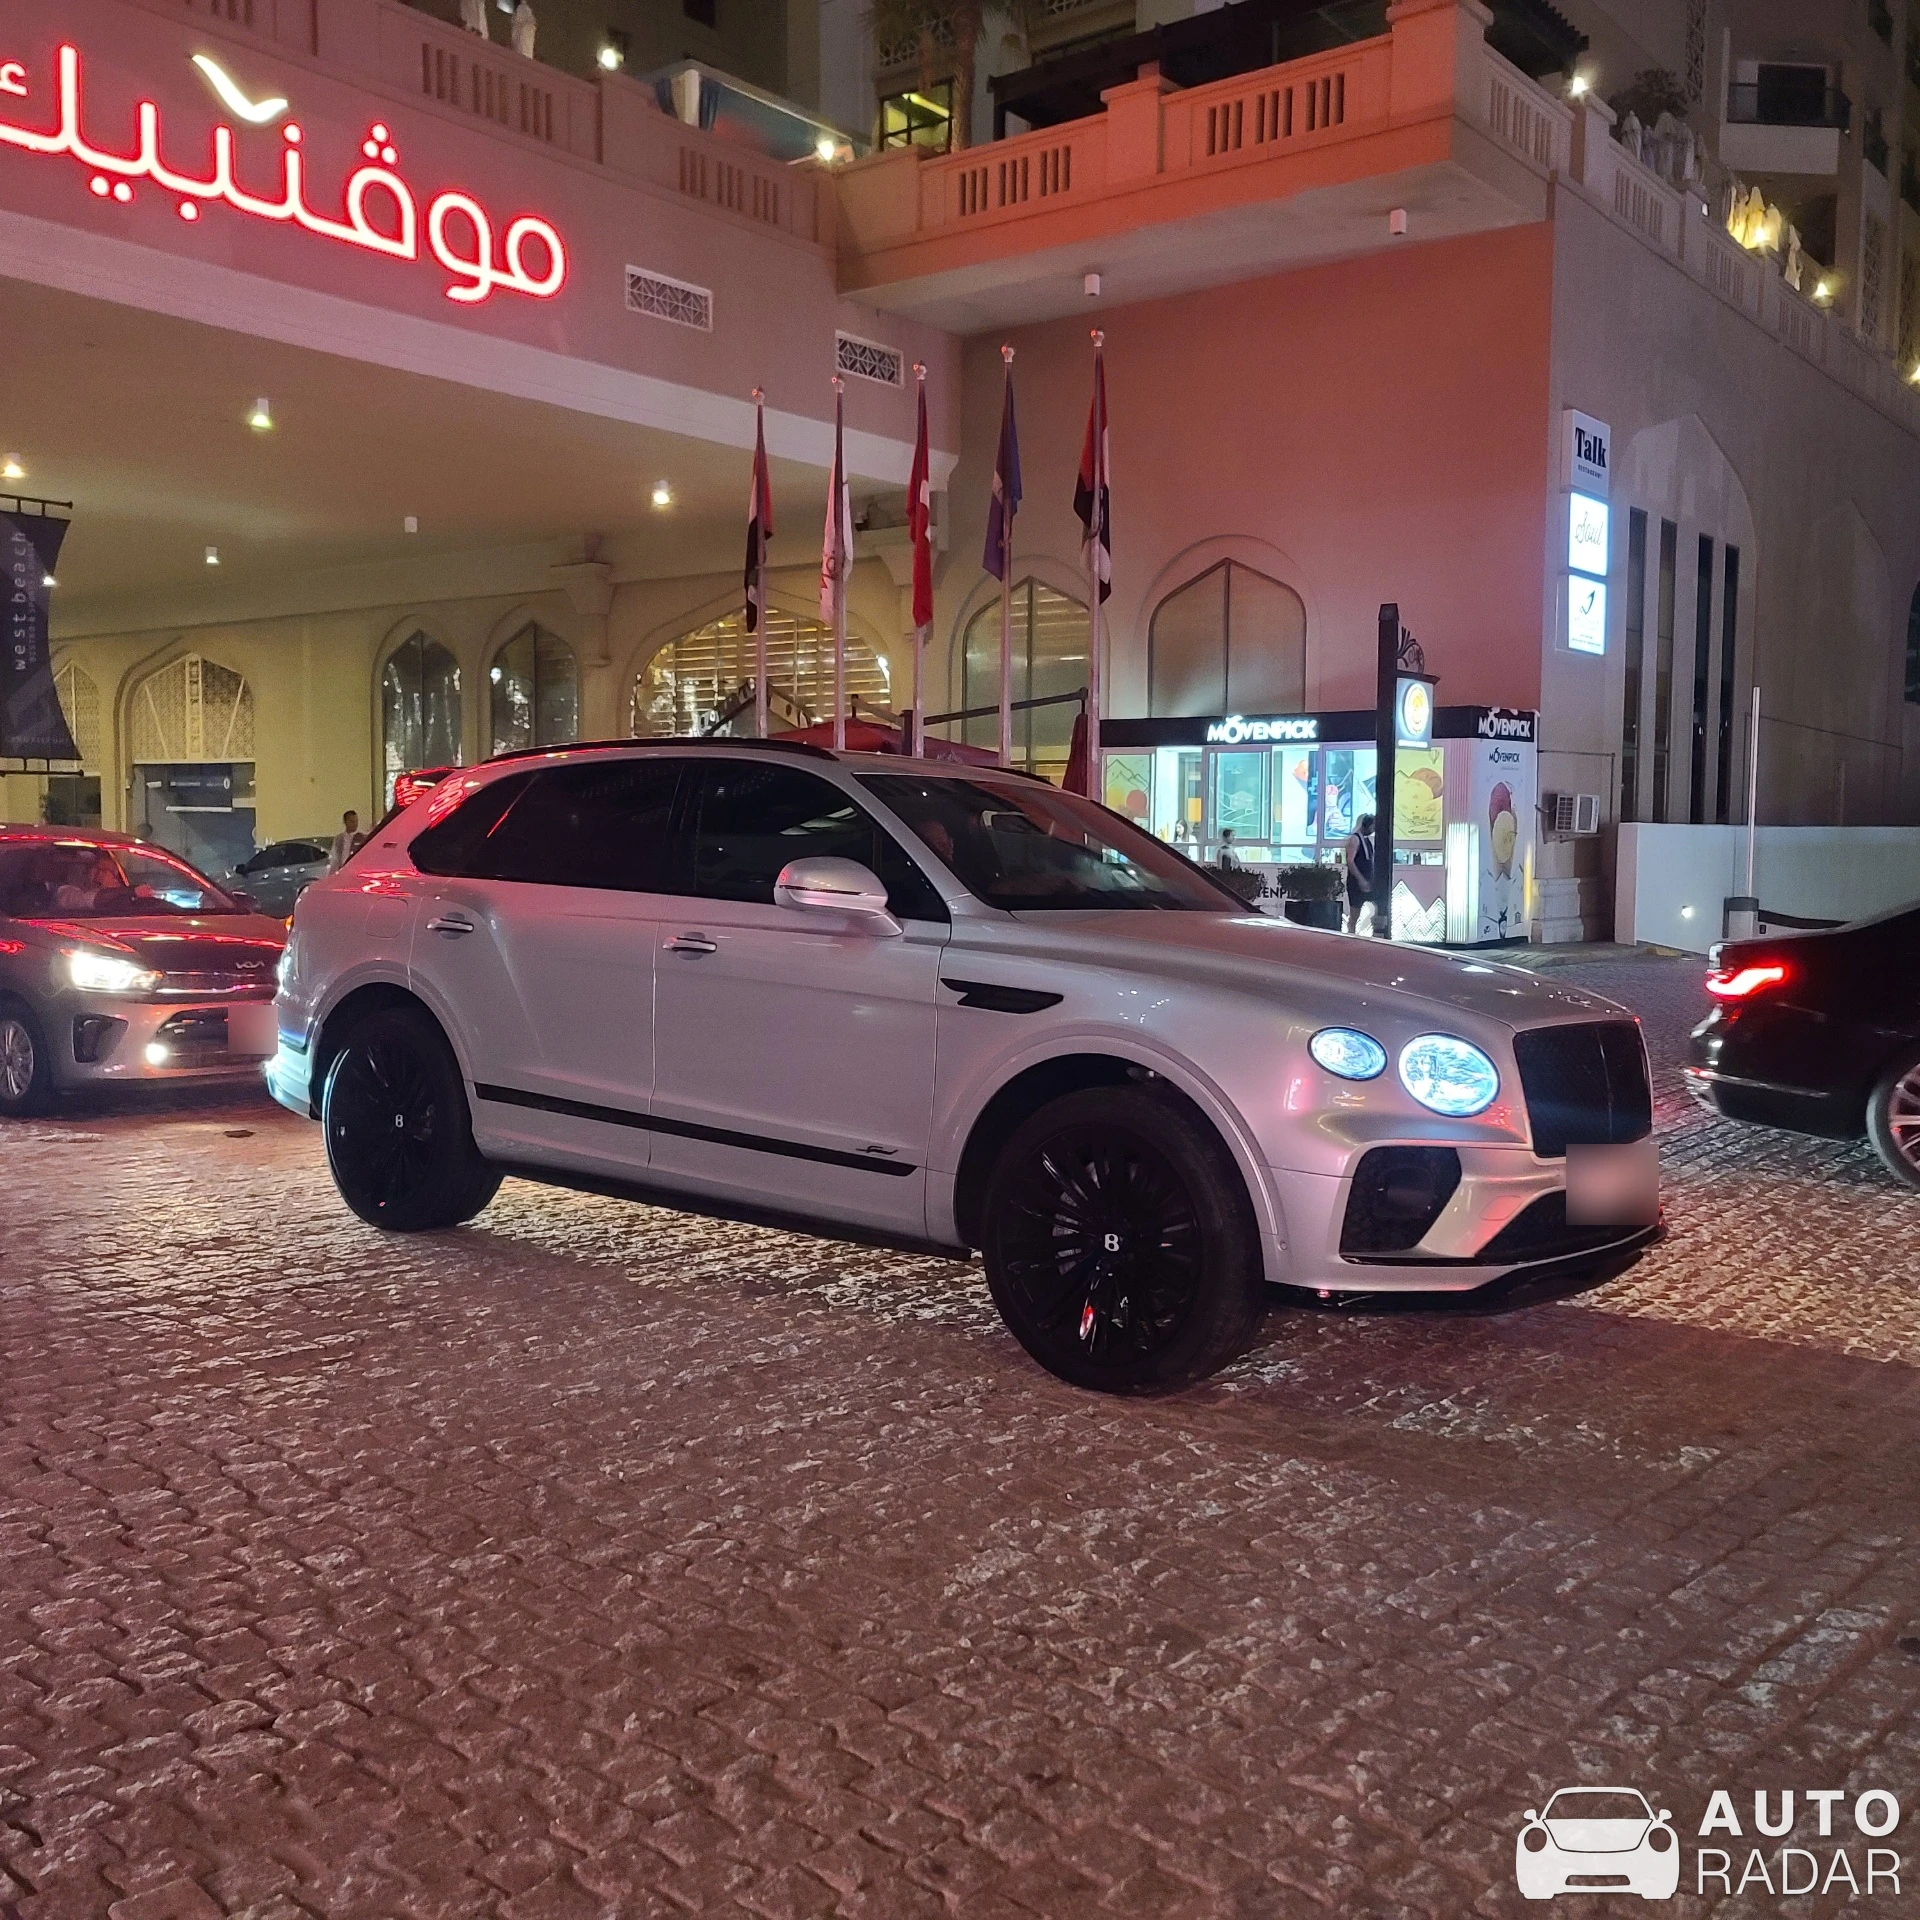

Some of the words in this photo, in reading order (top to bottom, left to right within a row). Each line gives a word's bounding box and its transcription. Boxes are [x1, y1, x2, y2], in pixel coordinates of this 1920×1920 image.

[1574, 427, 1607, 468] Talk
[1574, 511, 1604, 546] Soul
[10, 531, 26, 603] beach
[13, 613, 26, 671] west
[1104, 1233, 1120, 1252] B
